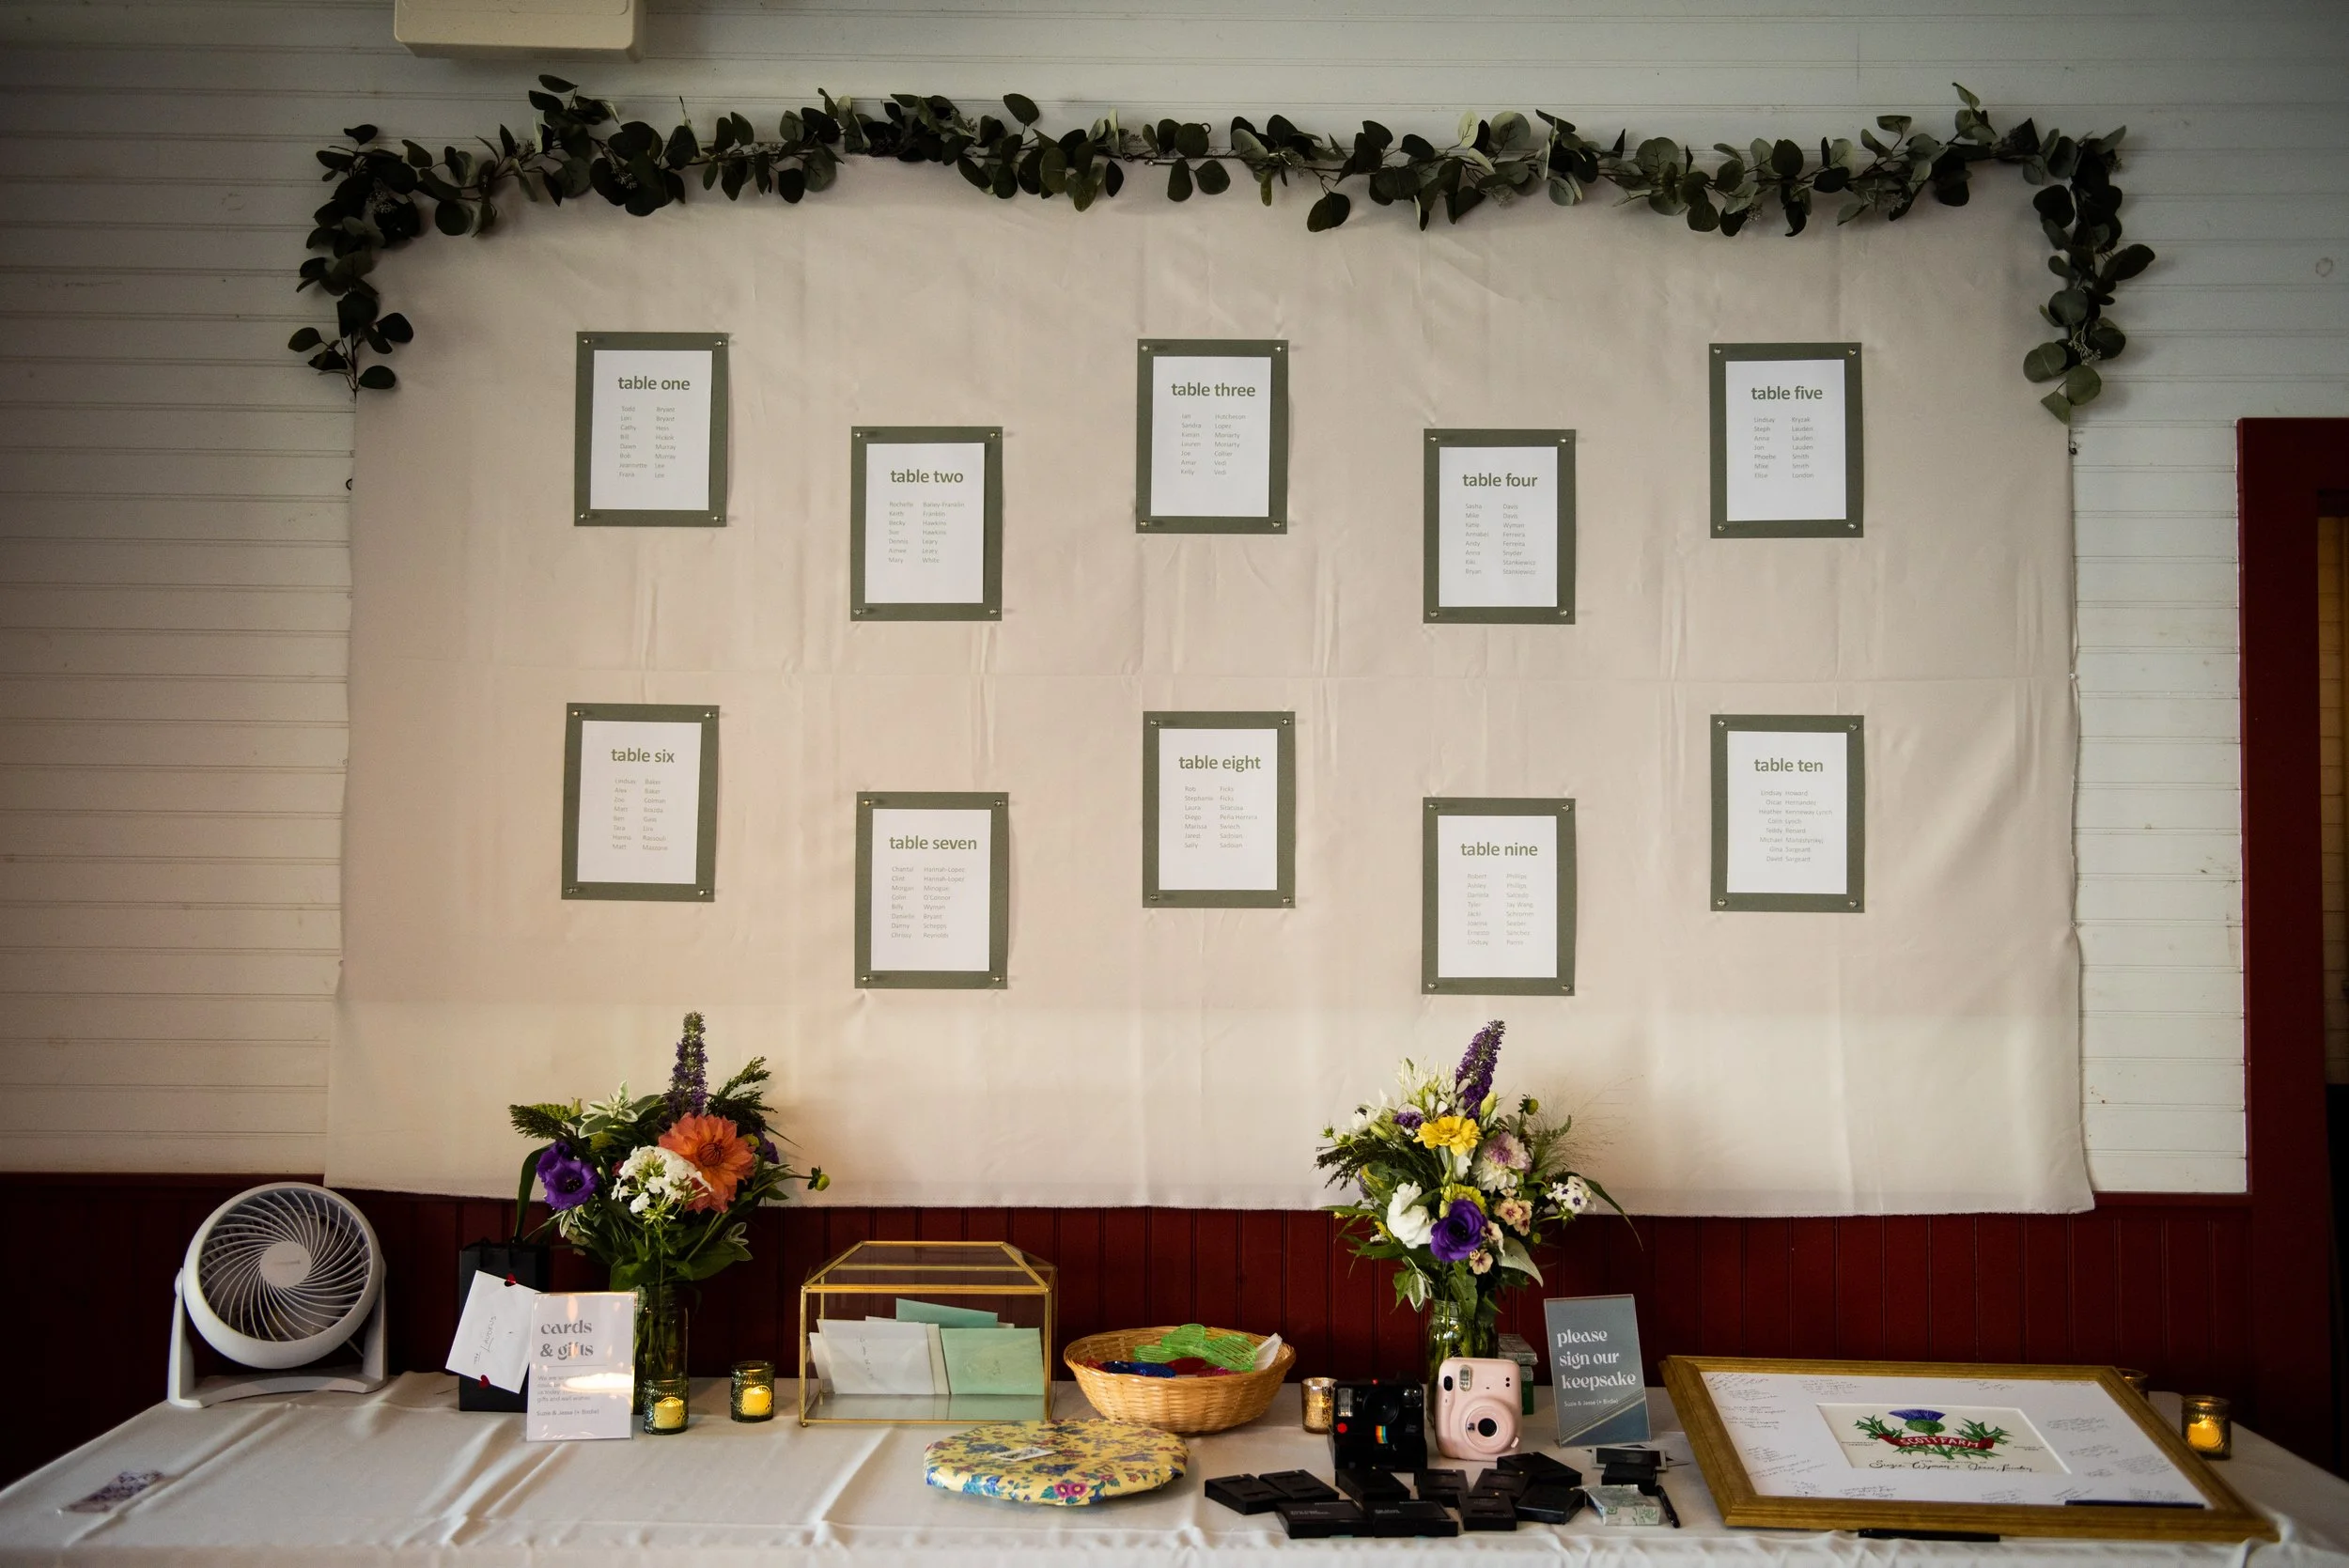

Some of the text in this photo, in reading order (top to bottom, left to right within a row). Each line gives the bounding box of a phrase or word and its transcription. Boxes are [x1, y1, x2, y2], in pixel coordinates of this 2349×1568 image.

[618, 376, 690, 390] table one
[1172, 382, 1255, 396] table three
[1751, 386, 1822, 399] table five
[891, 469, 963, 483] table two
[1463, 473, 1537, 487] table four
[612, 748, 674, 763] table six
[1179, 755, 1260, 772] table eight
[1754, 758, 1823, 771] table ten
[890, 835, 976, 849] table seven
[1461, 842, 1537, 856] table nine
[541, 1320, 592, 1334] cards
[1557, 1329, 1608, 1347] please
[540, 1343, 553, 1357] &
[1560, 1351, 1619, 1370] sign our
[1562, 1371, 1636, 1390] keepsake
[1900, 1437, 1979, 1448] SCOTT FARM
